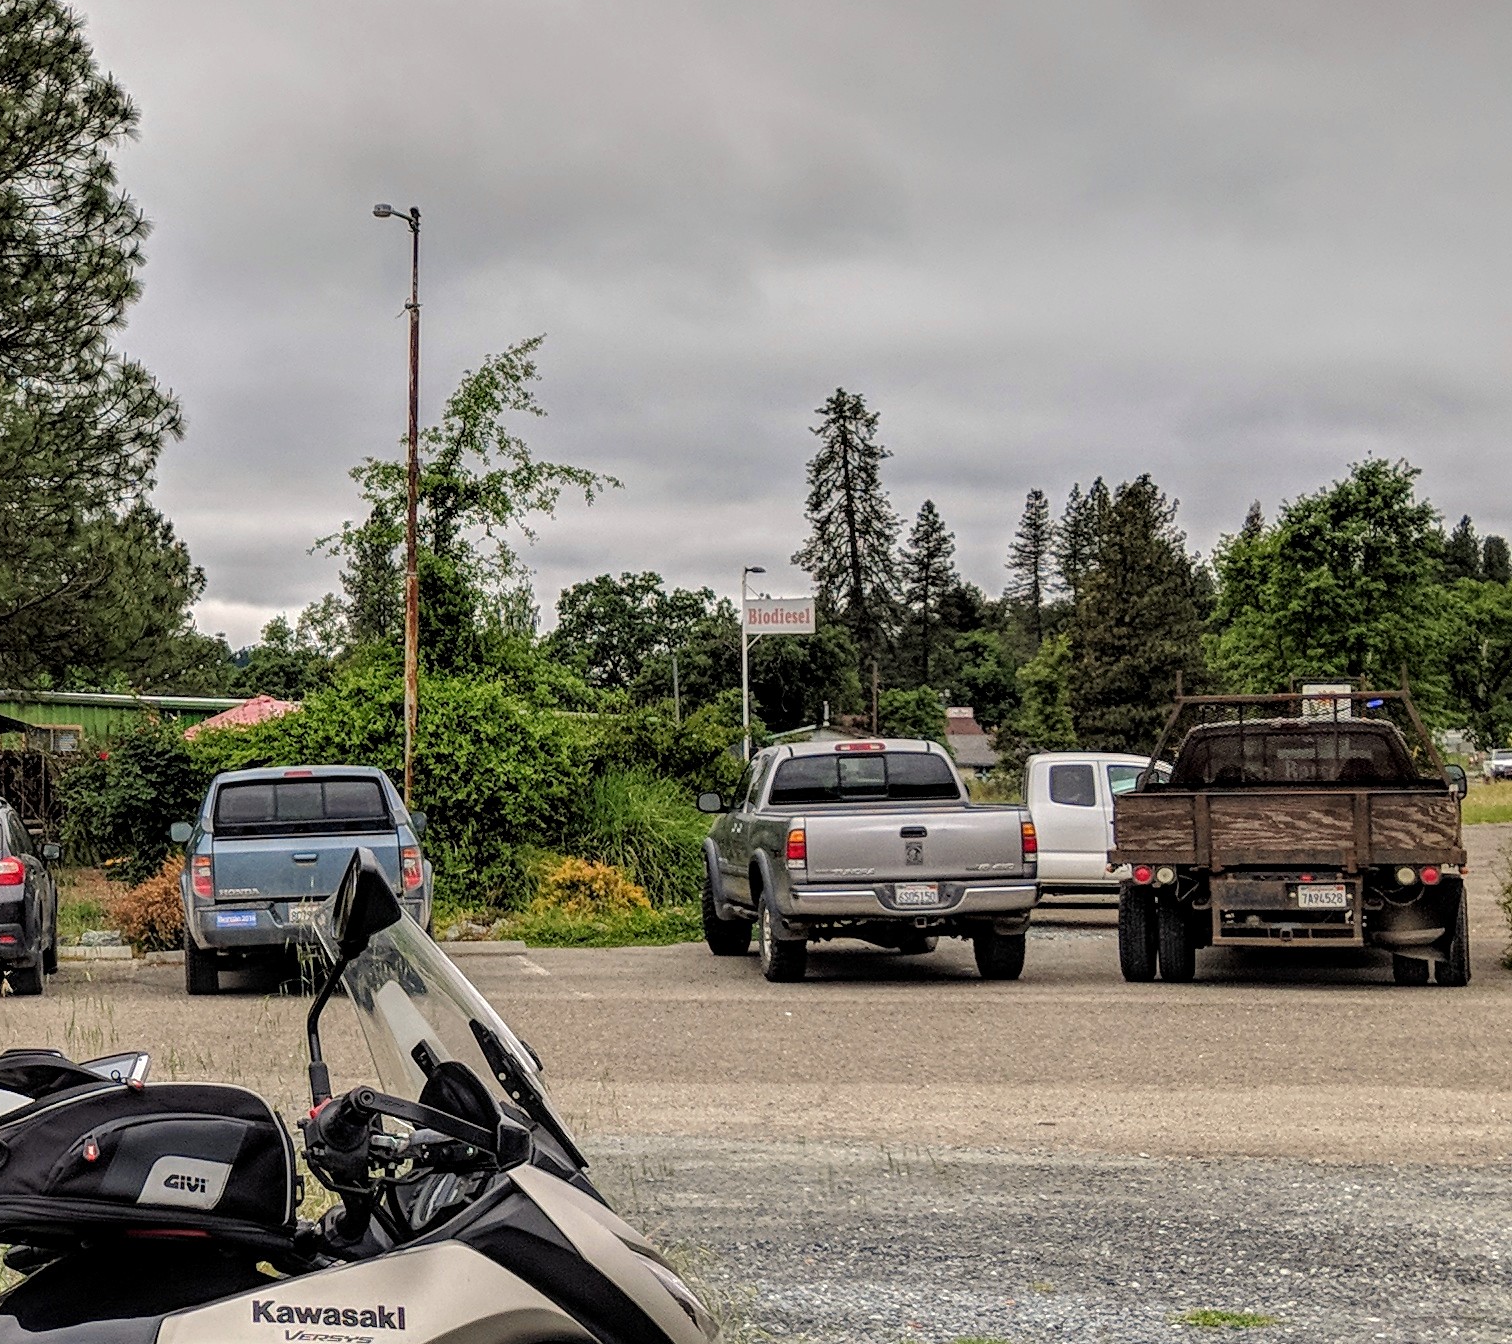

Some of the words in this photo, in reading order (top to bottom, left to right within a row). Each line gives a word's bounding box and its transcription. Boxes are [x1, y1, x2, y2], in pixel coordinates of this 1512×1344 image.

[748, 607, 811, 625] Biodiesel
[1302, 892, 1343, 905] 7A94528
[164, 1174, 206, 1193] GIVI
[252, 1299, 406, 1330] Kawasaki
[284, 1329, 375, 1344] VERSYS
